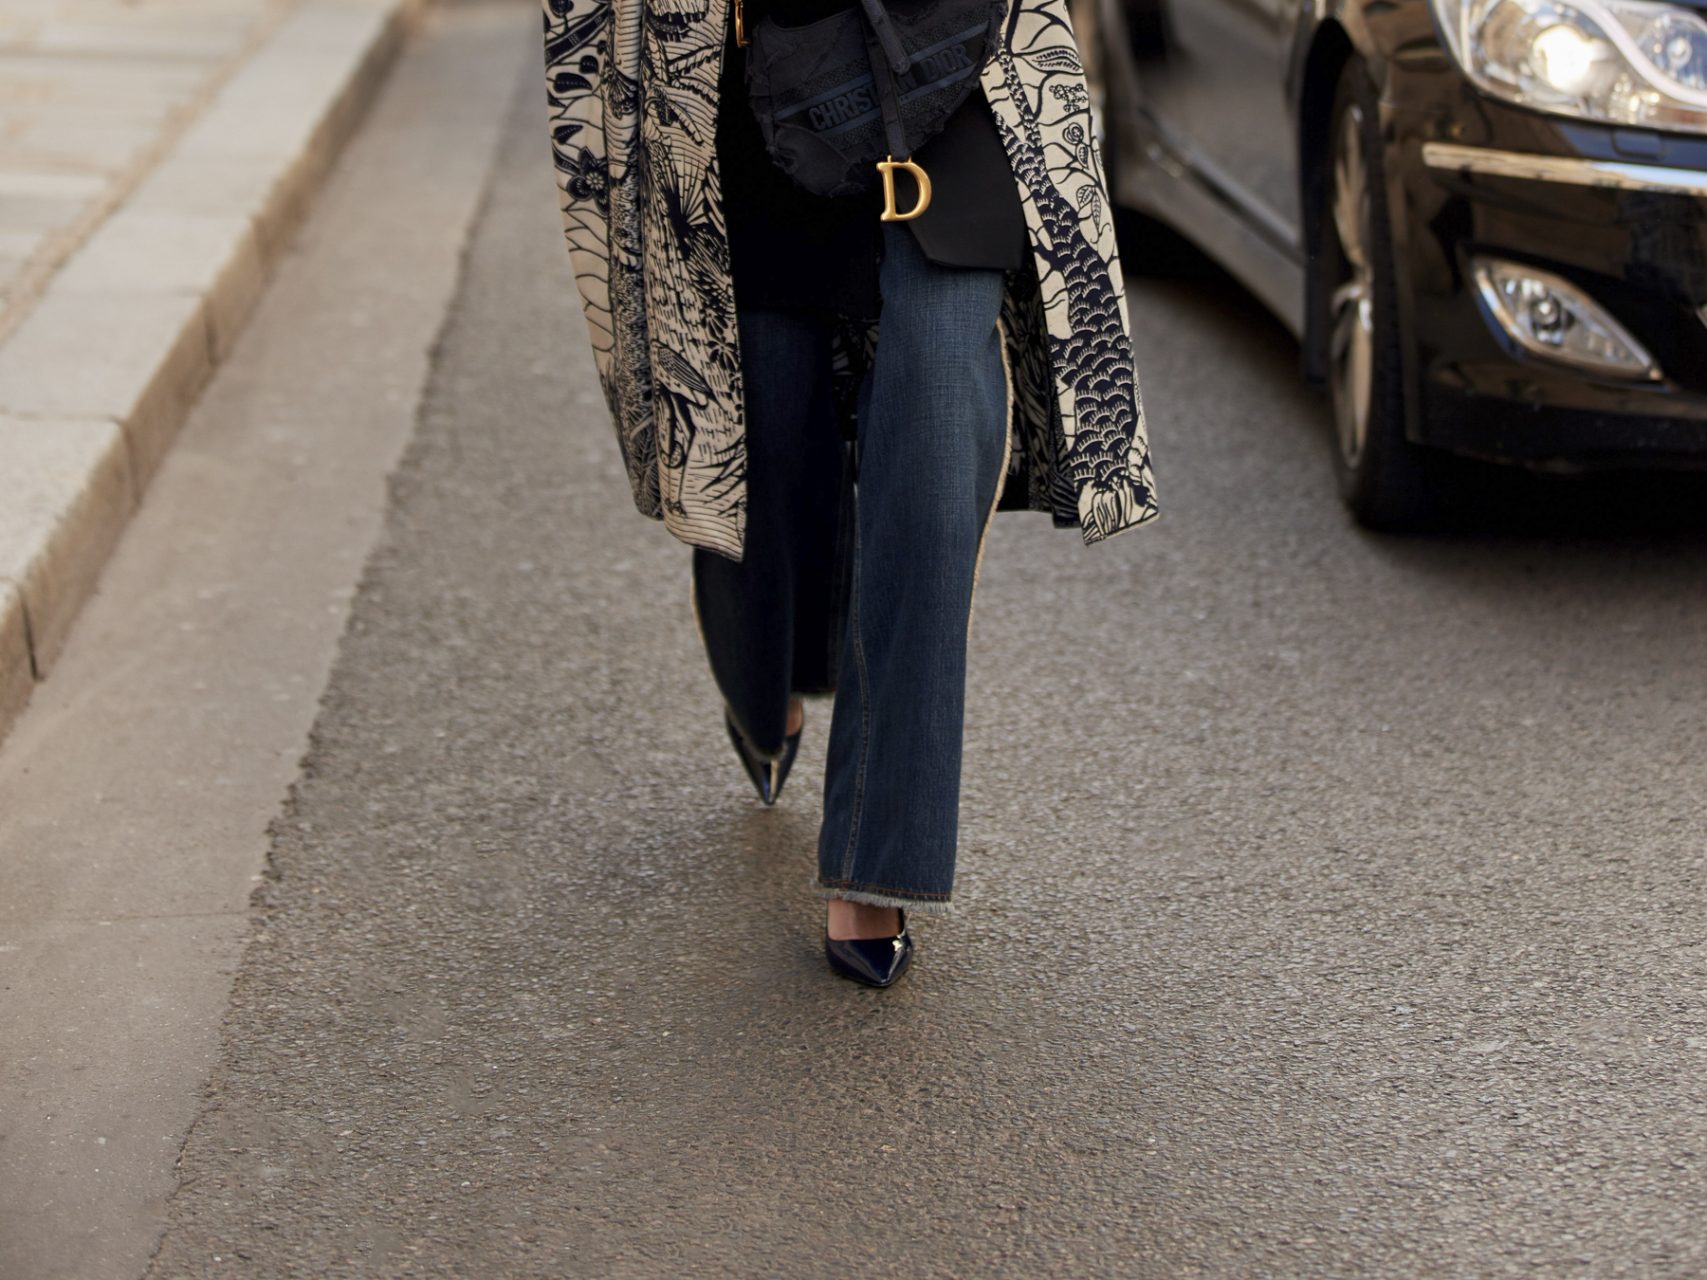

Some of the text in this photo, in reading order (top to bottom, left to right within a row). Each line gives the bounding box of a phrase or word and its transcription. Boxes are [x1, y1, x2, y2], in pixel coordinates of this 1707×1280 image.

[808, 43, 974, 131] CHRISTN DIOR
[876, 160, 932, 222] D
